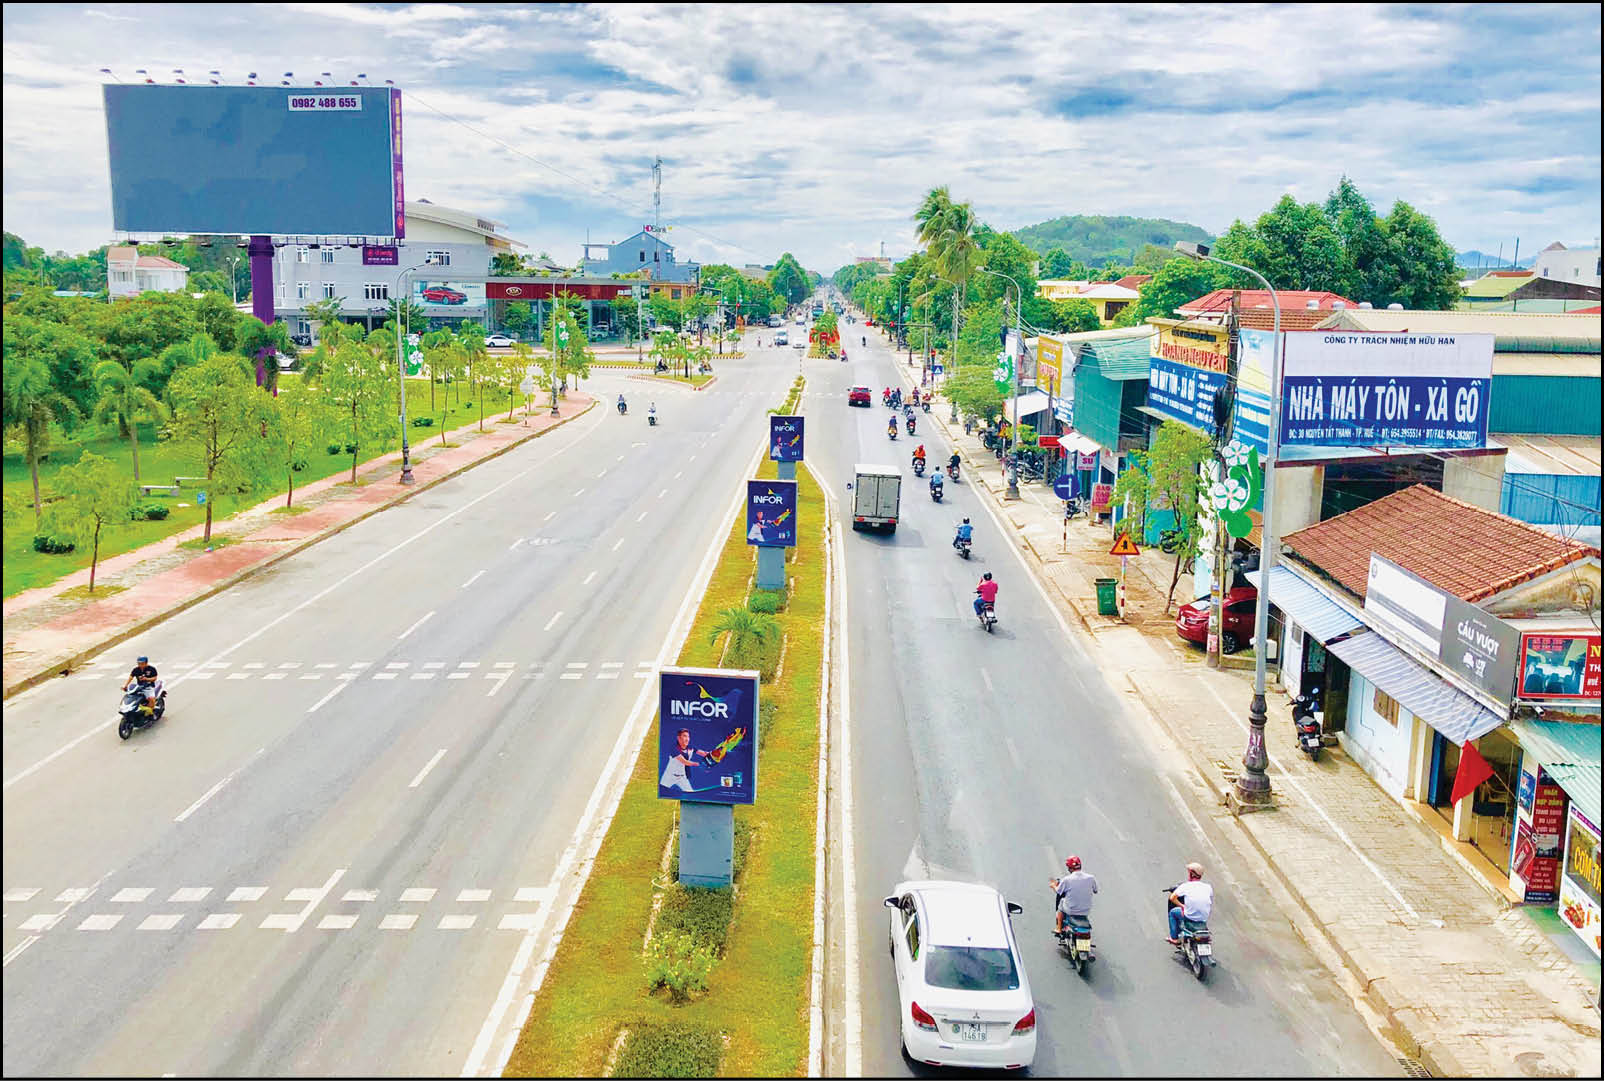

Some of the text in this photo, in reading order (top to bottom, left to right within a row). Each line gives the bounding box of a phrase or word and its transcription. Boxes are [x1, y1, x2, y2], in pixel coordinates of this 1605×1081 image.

[292, 98, 357, 108] 0982 488 655
[1324, 335, 1346, 344] CÔNG
[1348, 336, 1358, 344] TY
[1361, 335, 1387, 345] TRÁCH
[1289, 378, 1324, 421] NHÀ
[1330, 378, 1370, 421] MÁY
[1375, 378, 1410, 421] TÔN
[1425, 379, 1448, 422] XÀ
[1455, 380, 1482, 424] GỒ
[1363, 423, 1375, 438] HUẾ
[753, 495, 783, 504] INFOR
[670, 699, 729, 719] INFOR
